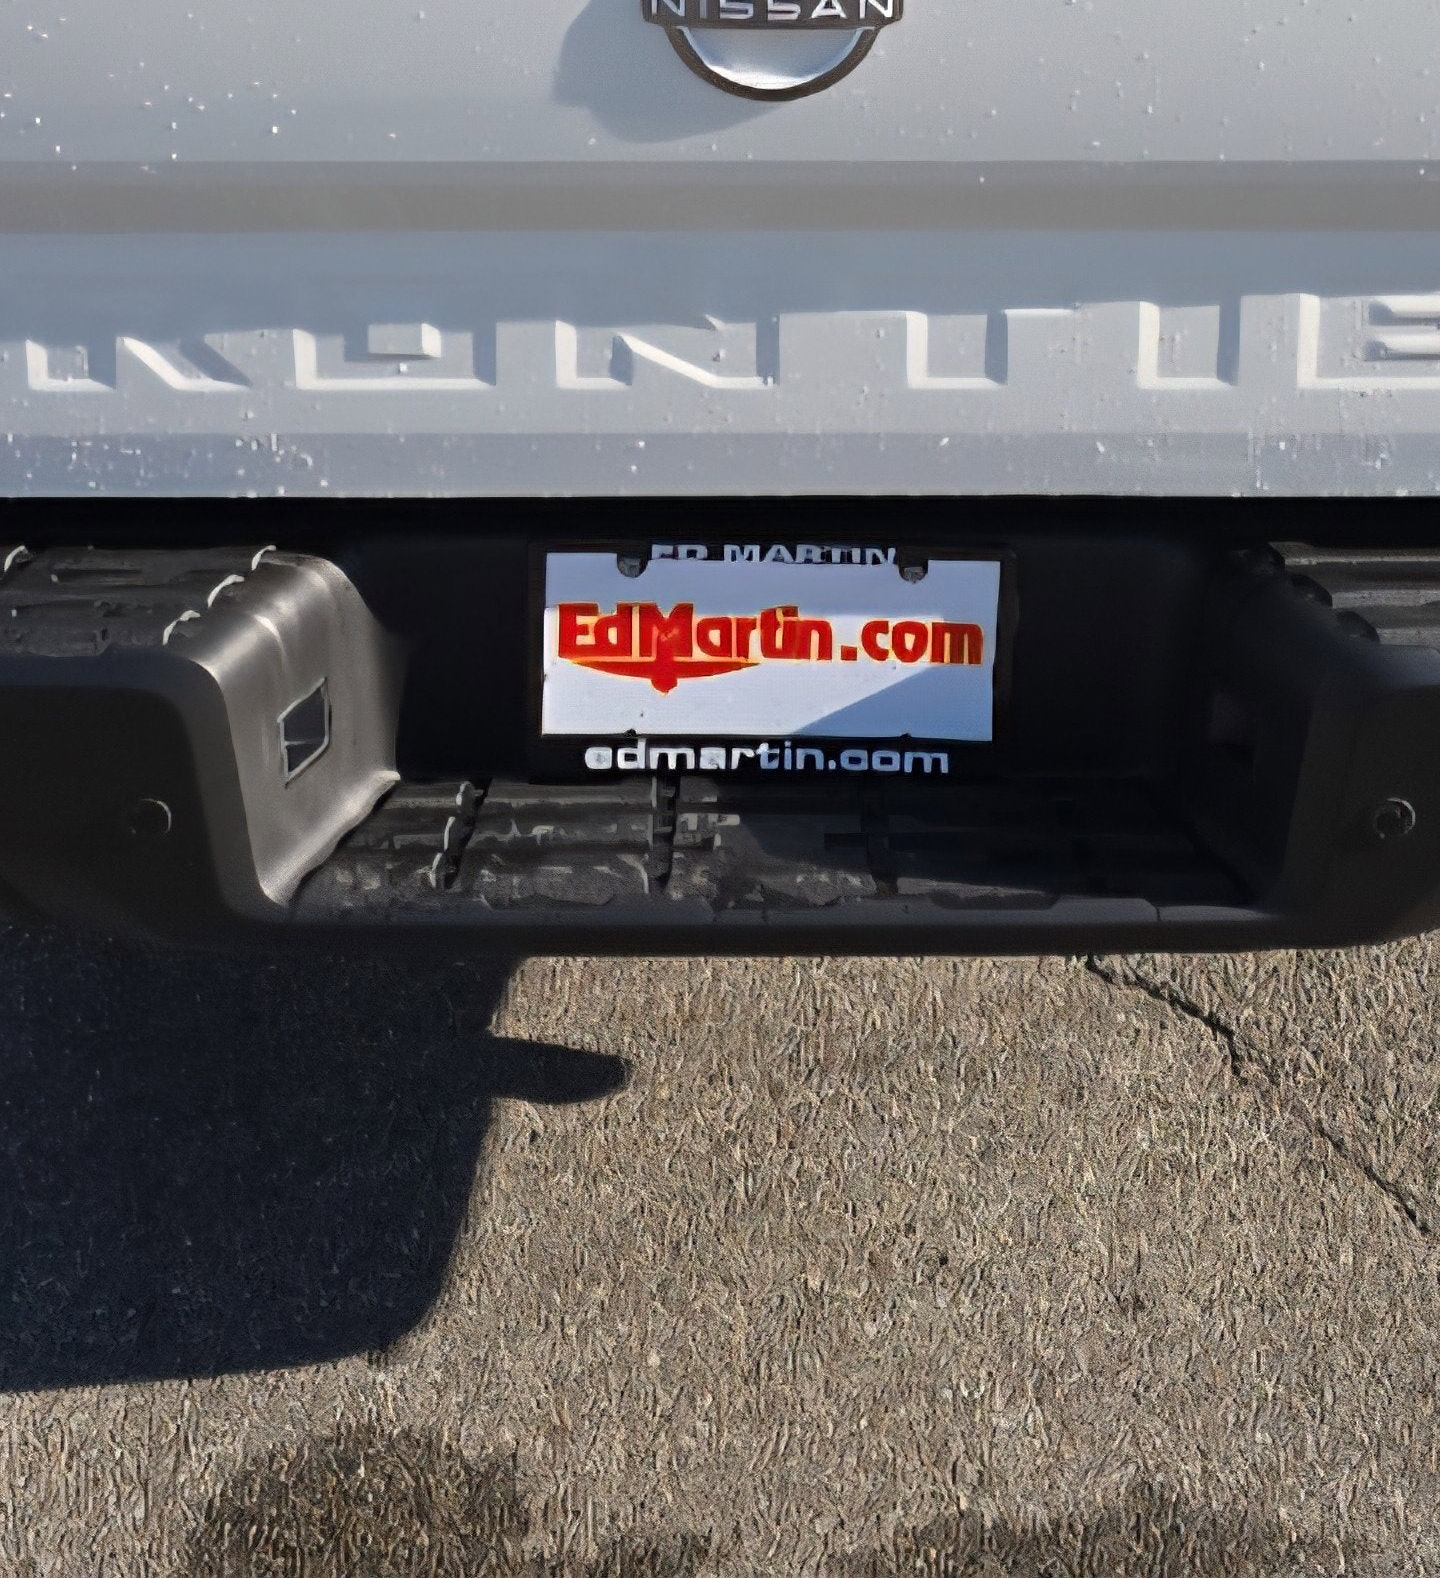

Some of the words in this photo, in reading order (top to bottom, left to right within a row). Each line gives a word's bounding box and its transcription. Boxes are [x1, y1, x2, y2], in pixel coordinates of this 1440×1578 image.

[723, 544, 897, 564] MARTIN
[558, 601, 984, 666] EdMartin.com
[584, 739, 950, 774] edmartin.com
